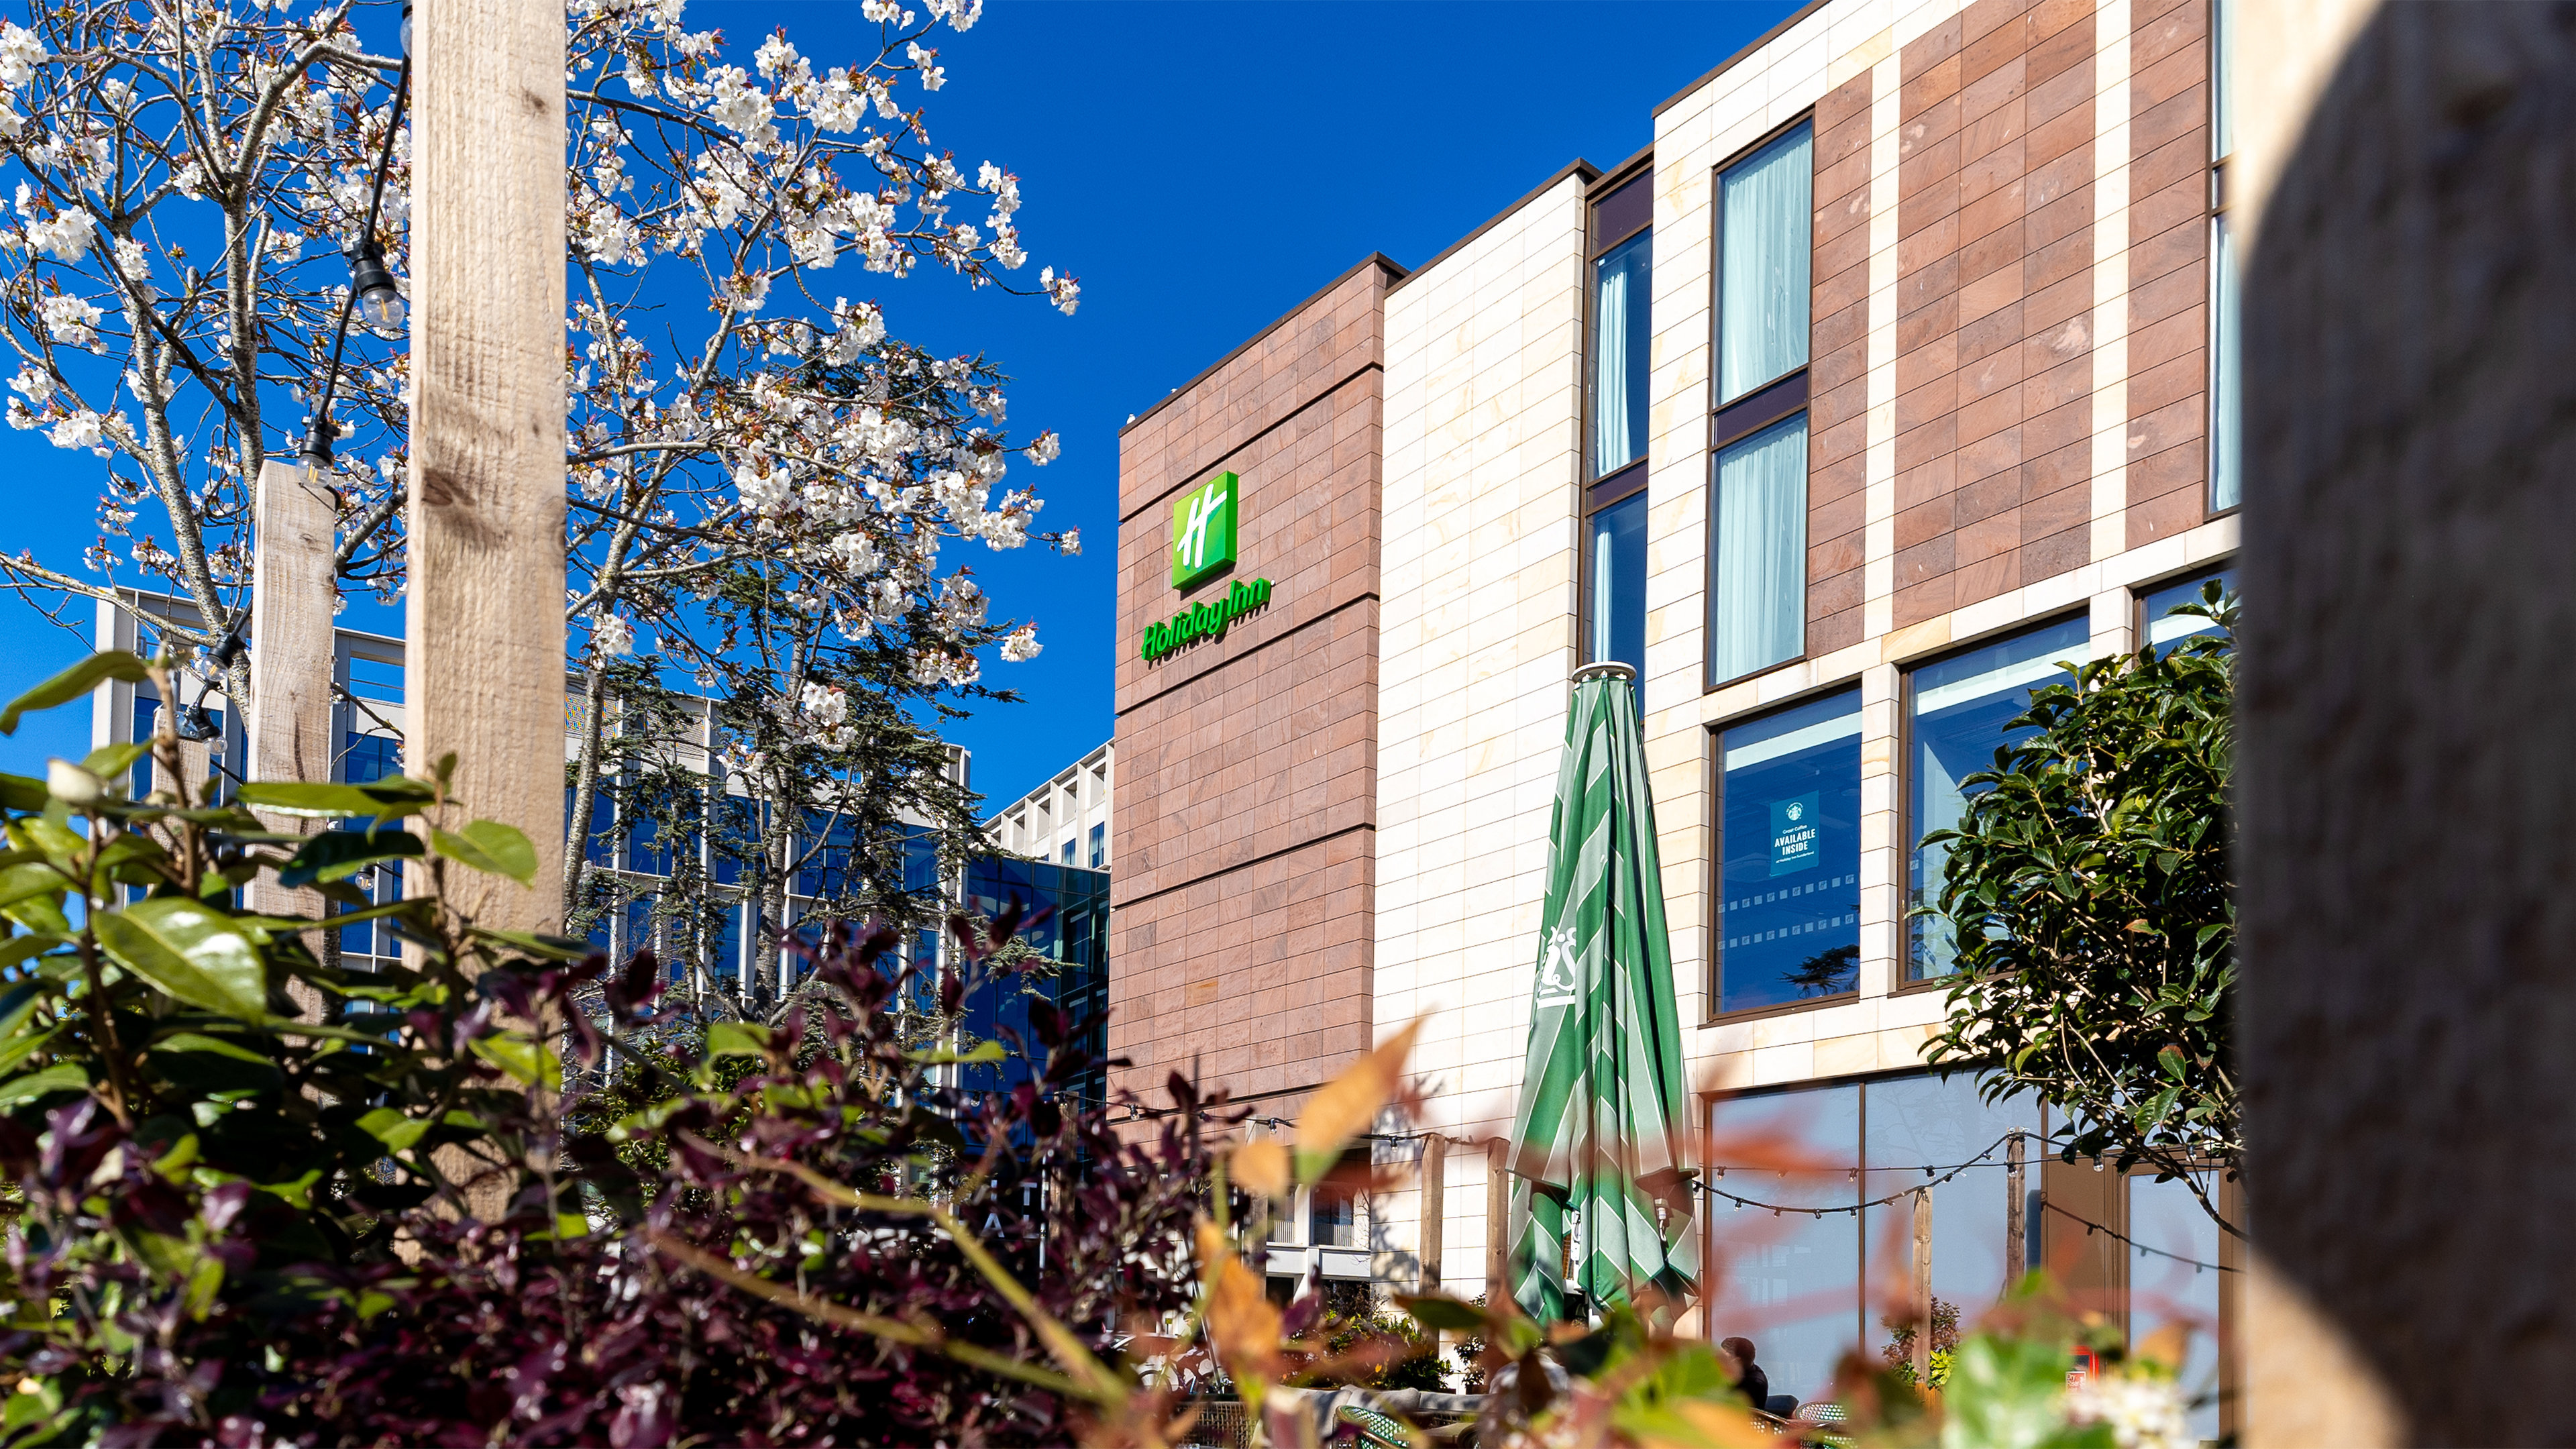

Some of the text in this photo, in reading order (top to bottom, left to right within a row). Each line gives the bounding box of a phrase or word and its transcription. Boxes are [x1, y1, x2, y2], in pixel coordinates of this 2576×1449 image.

[1141, 578, 1271, 661] Holiday Inn
[1774, 828, 1816, 848] AVAILABLE
[1782, 841, 1808, 856] INSIDE
